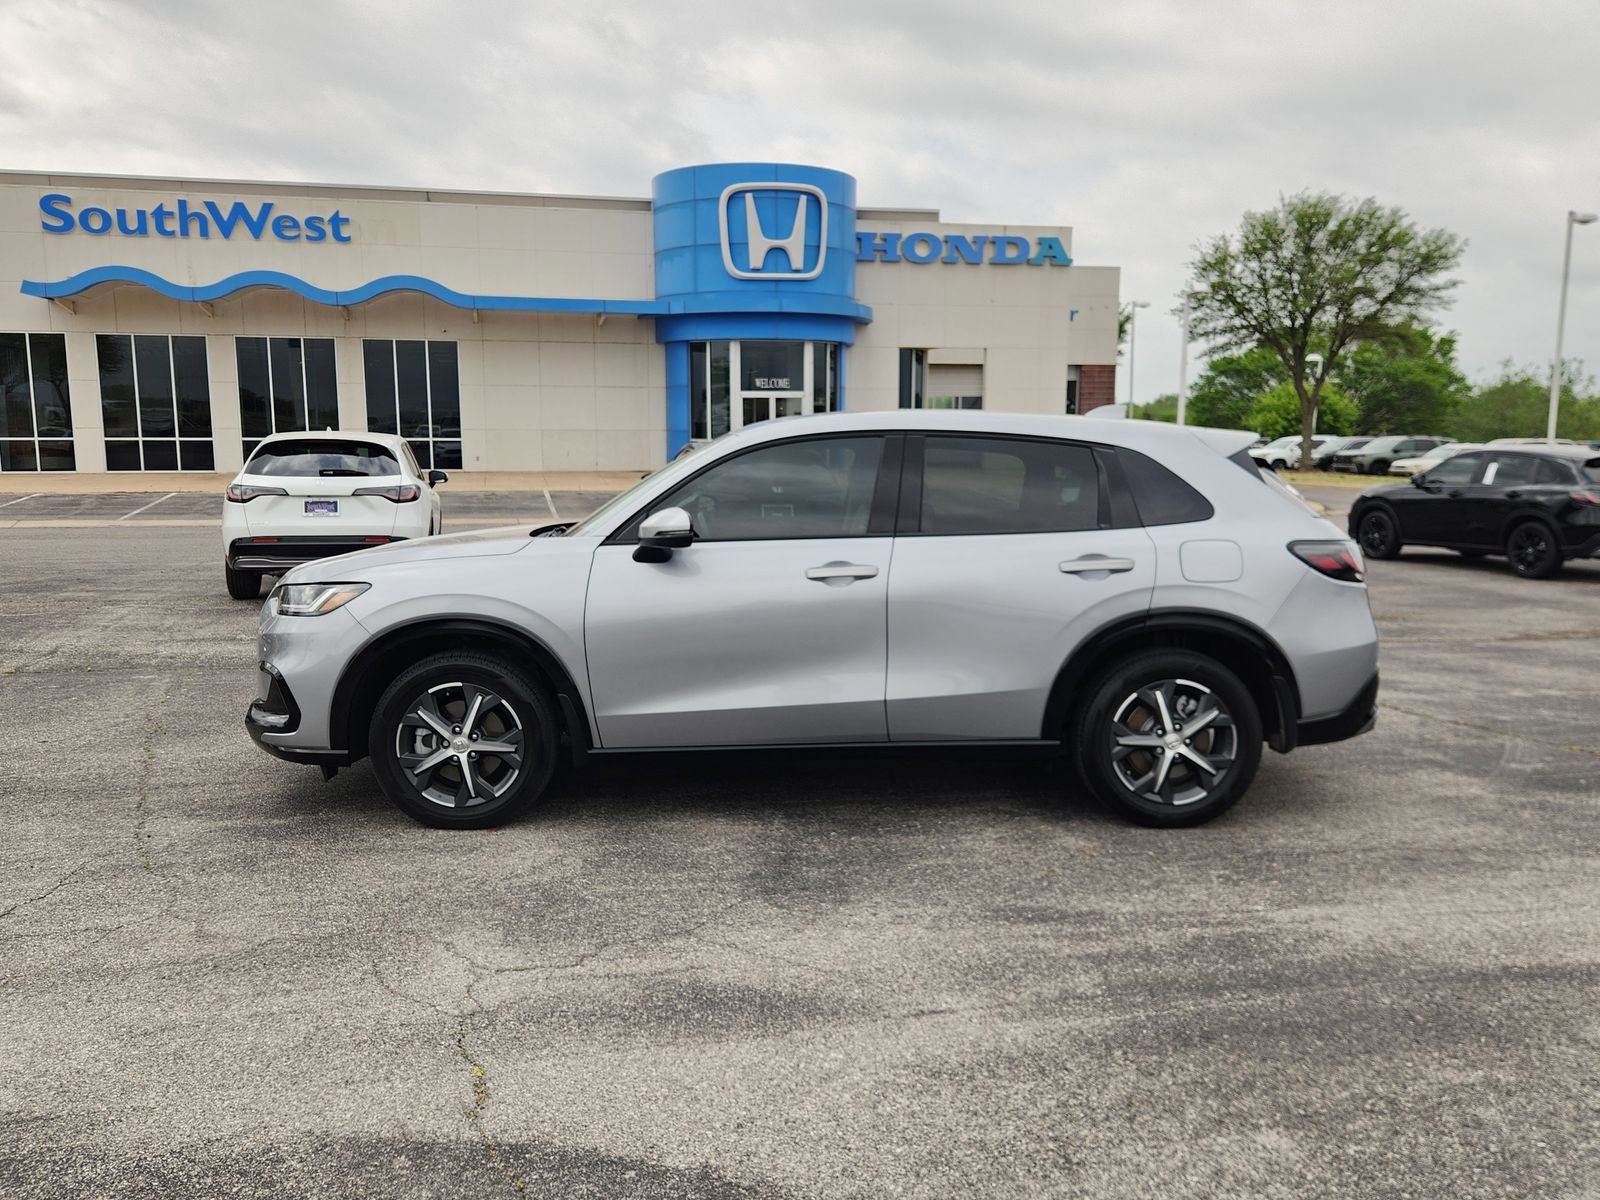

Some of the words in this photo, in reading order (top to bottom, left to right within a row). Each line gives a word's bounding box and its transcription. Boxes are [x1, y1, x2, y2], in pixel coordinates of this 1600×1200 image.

[39, 193, 351, 242] SouthWest
[856, 232, 1073, 266] HONDA
[755, 378, 791, 389] WELCOME
